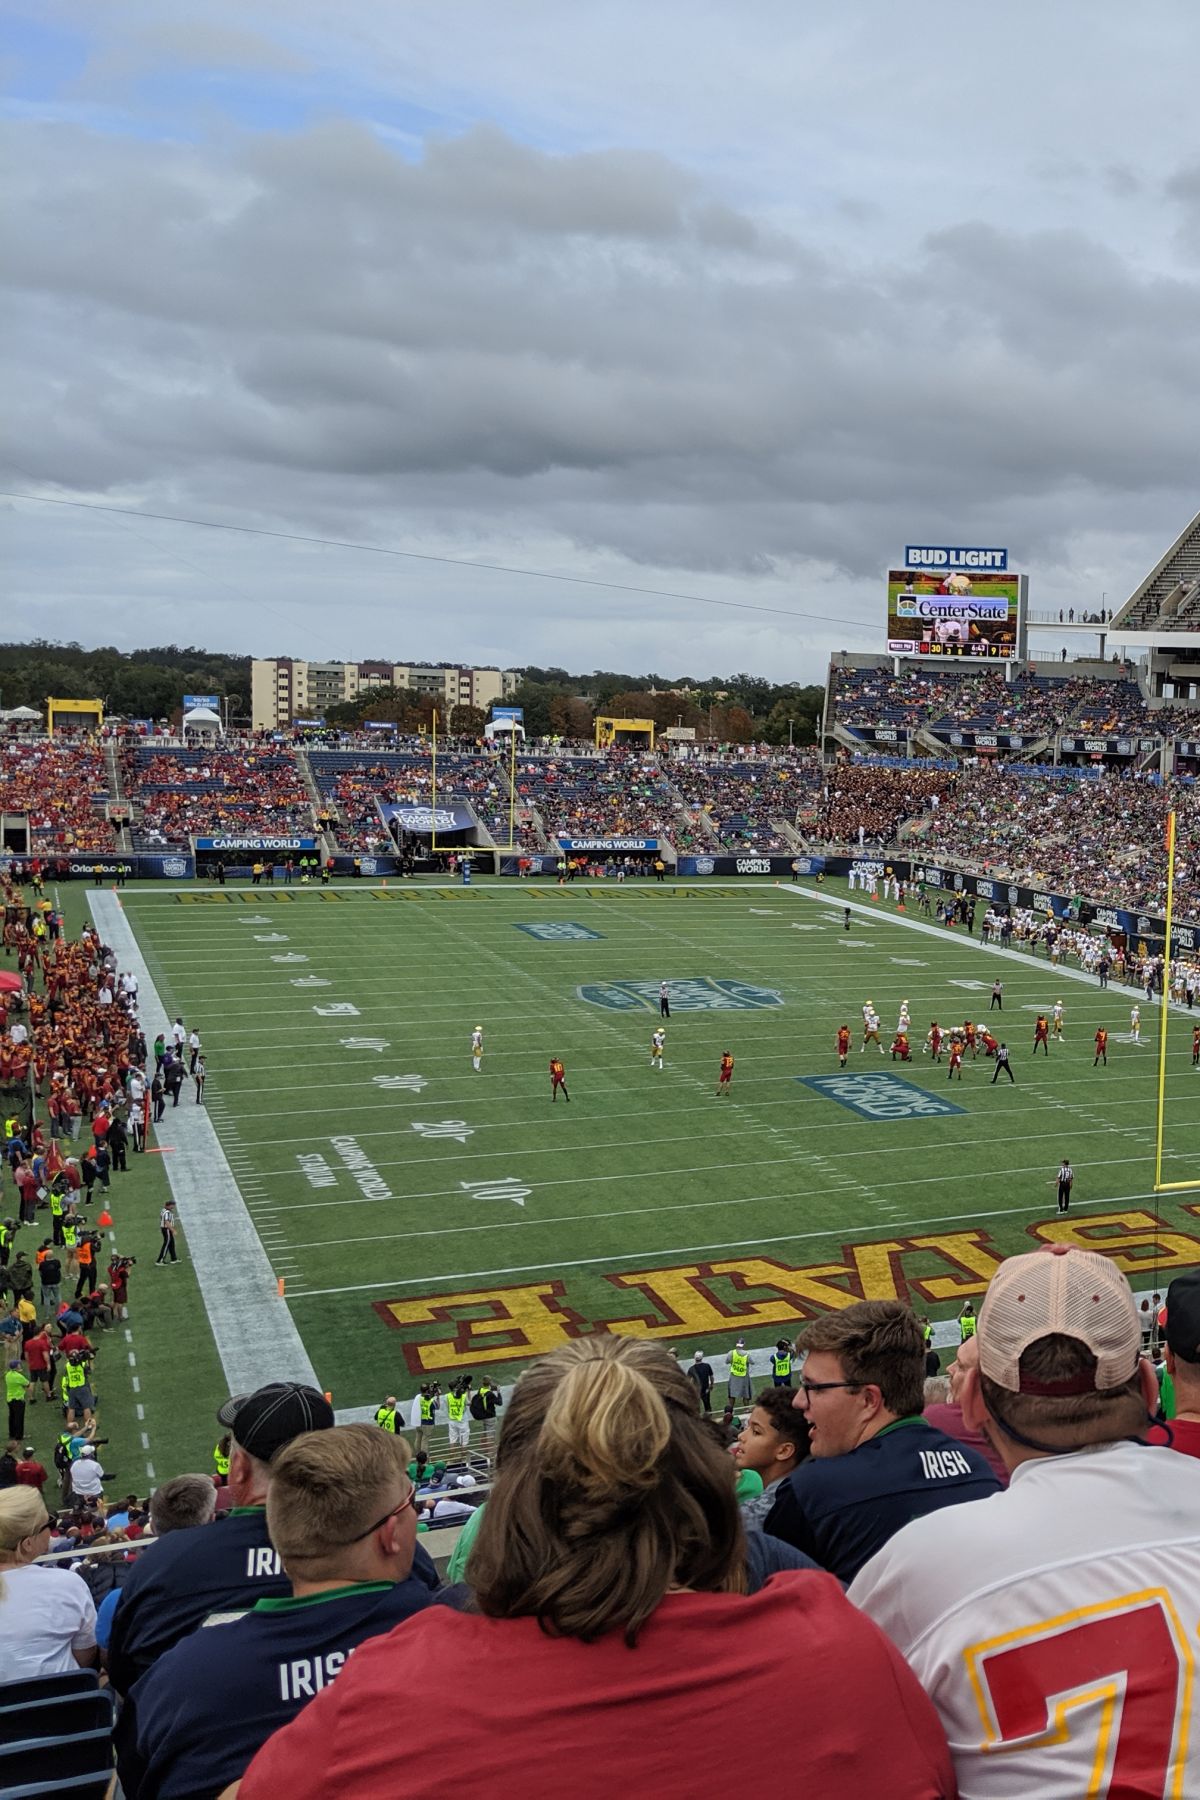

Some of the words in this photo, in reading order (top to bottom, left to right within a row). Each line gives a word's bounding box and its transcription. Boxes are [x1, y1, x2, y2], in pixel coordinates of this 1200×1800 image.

[908, 549, 947, 565] BUD
[950, 550, 1004, 567] LIGHT
[919, 603, 1006, 619] CenterState
[990, 647, 996, 655] 9
[213, 839, 260, 848] CAMPING
[262, 839, 300, 848] WORLD
[571, 840, 612, 849] CAMPING
[613, 840, 646, 849] WORLD
[736, 858, 771, 866] CAMPING
[737, 865, 771, 873] WORLD
[852, 861, 884, 869] CAMPING
[925, 867, 941, 878] CAMPING
[926, 875, 941, 886] WORLD
[977, 880, 994, 891] CAMPING
[977, 887, 993, 898] WORLD
[1033, 893, 1052, 904] CAMPING
[1096, 907, 1118, 919] CAMPING
[1171, 925, 1194, 938] CAMPING
[371, 1074, 428, 1089] 30
[815, 1077, 912, 1117] WORLD
[854, 1074, 951, 1113] CAMPING
[410, 1120, 475, 1138] 20
[330, 1136, 375, 1169] CAMPING
[296, 1153, 339, 1188] STADIUM
[351, 1167, 393, 1200] WORLD
[459, 1177, 533, 1200] 10
[918, 1449, 973, 1480] IRISH
[247, 1547, 282, 1577] IRI
[280, 1648, 355, 1701] IRIS
